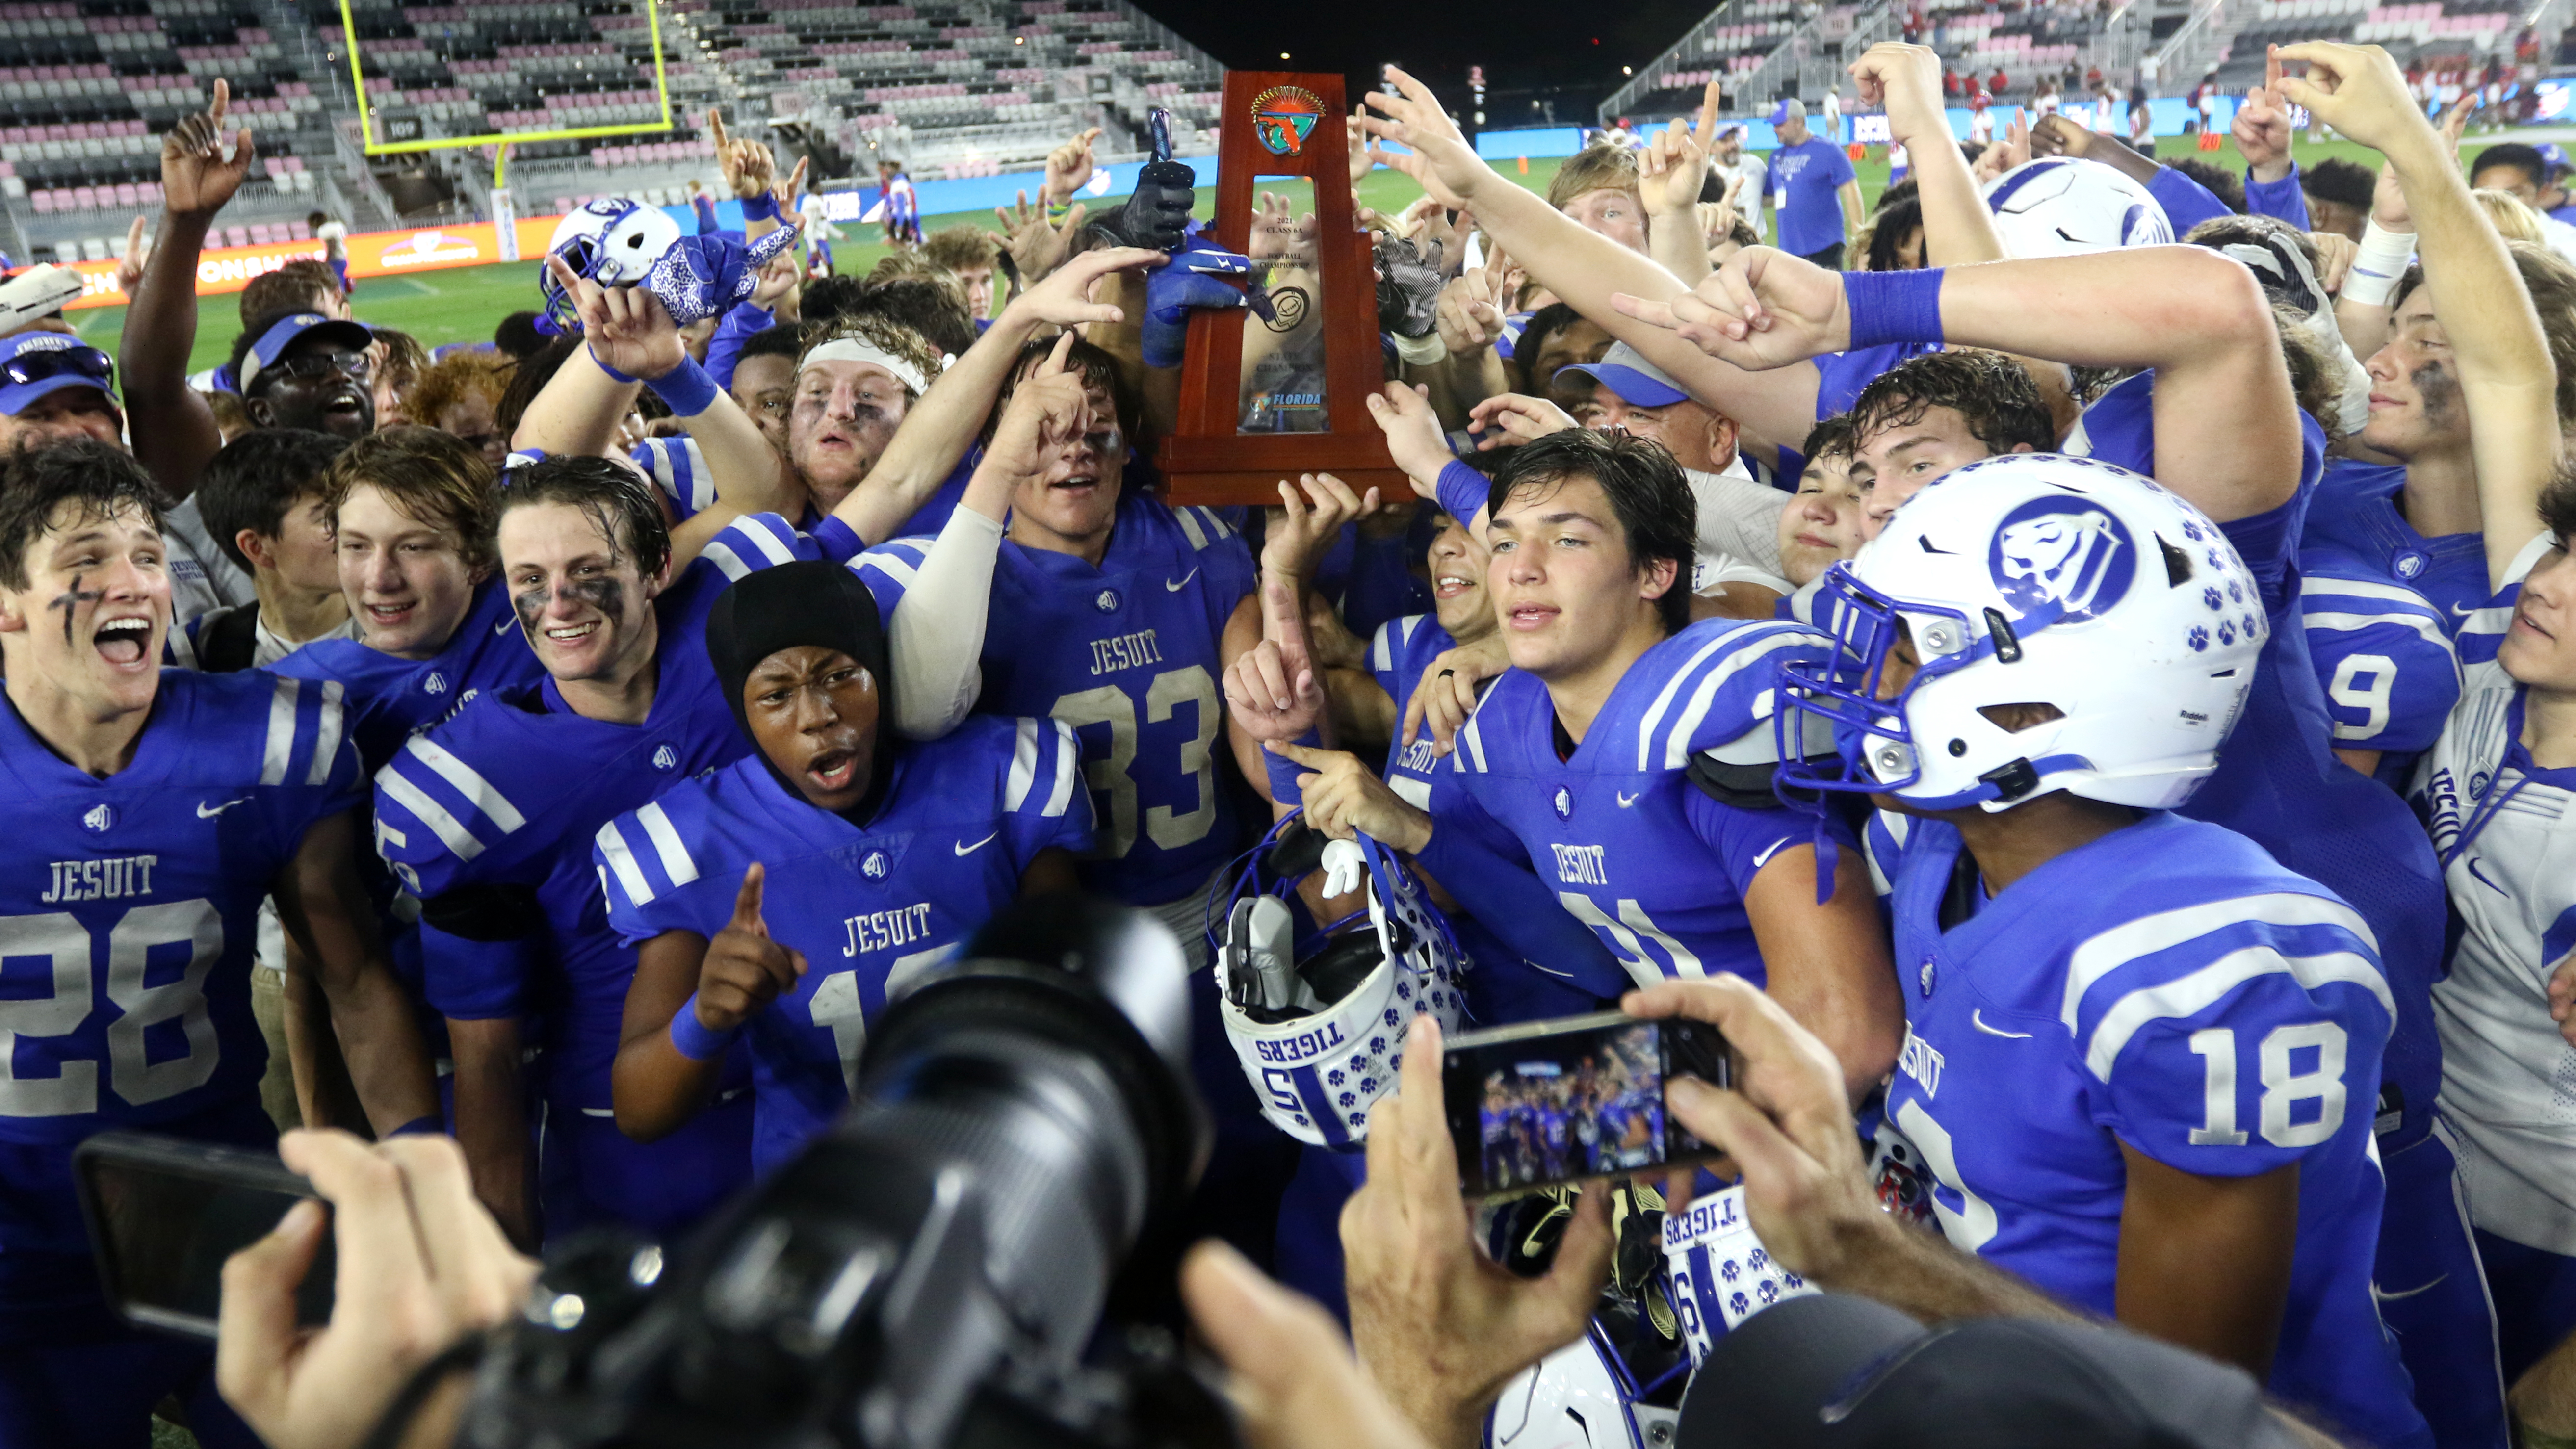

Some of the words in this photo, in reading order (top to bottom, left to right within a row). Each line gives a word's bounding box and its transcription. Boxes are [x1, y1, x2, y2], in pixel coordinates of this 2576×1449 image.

[390, 121, 416, 137] 109
[1274, 394, 1321, 405] FLORIDA
[1090, 628, 1163, 675] JESUIT
[2180, 709, 2210, 722] Riddell
[2329, 653, 2398, 740] 9
[41, 854, 157, 904] JESUIT
[1551, 843, 1608, 885] JESUIT
[842, 902, 931, 958] JESUIT
[0, 897, 225, 1117] 28
[1255, 1020, 1346, 1063] TIGERS
[1261, 1067, 1305, 1119] 5
[2188, 1021, 2348, 1148] 18
[1666, 1196, 1737, 1247] TIGERS
